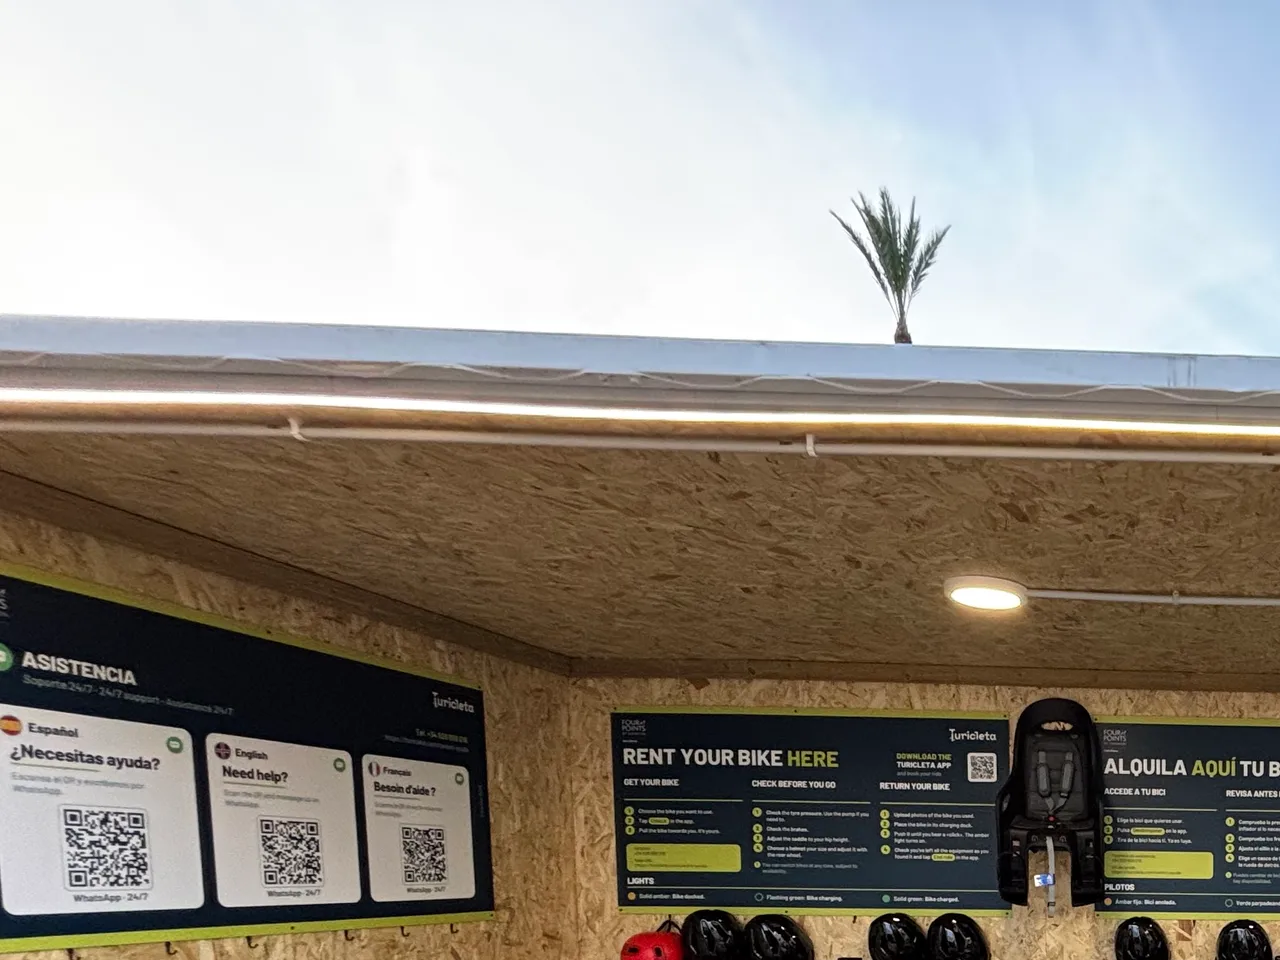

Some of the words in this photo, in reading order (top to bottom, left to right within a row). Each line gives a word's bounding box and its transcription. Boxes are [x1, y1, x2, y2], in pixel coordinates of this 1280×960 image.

[22, 651, 138, 685] ASISTENCIA
[22, 675, 67, 690] Soporte
[69, 683, 93, 694] 24/7
[100, 687, 123, 698] 24/7
[432, 692, 474, 713] Turicleta
[28, 723, 78, 738] Español
[949, 729, 997, 742] Turicleta
[10, 744, 103, 764] ¿Necesitas
[107, 756, 160, 769] ayuda?
[235, 749, 268, 760] English
[624, 748, 675, 765] RENT
[681, 749, 734, 765] YOUR
[738, 750, 783, 766] BIKE
[788, 750, 839, 767] HERE
[383, 767, 411, 777] Français
[1104, 758, 1187, 776] ALQUILA
[1192, 757, 1236, 777] AQUÍ
[1240, 761, 1264, 777] TU
[222, 766, 254, 779] Need
[257, 769, 288, 783] help?
[374, 782, 404, 793] Besoin
[406, 784, 429, 796] d'aide
[431, 787, 435, 796] ?
[880, 782, 910, 790] RETURN
[912, 782, 932, 790] YOUR
[933, 783, 950, 791] BIKE
[1254, 790, 1278, 798] ANTES
[627, 877, 654, 885] LIGHTS
[73, 894, 121, 903] WhatsApp
[128, 893, 148, 901] 24/7
